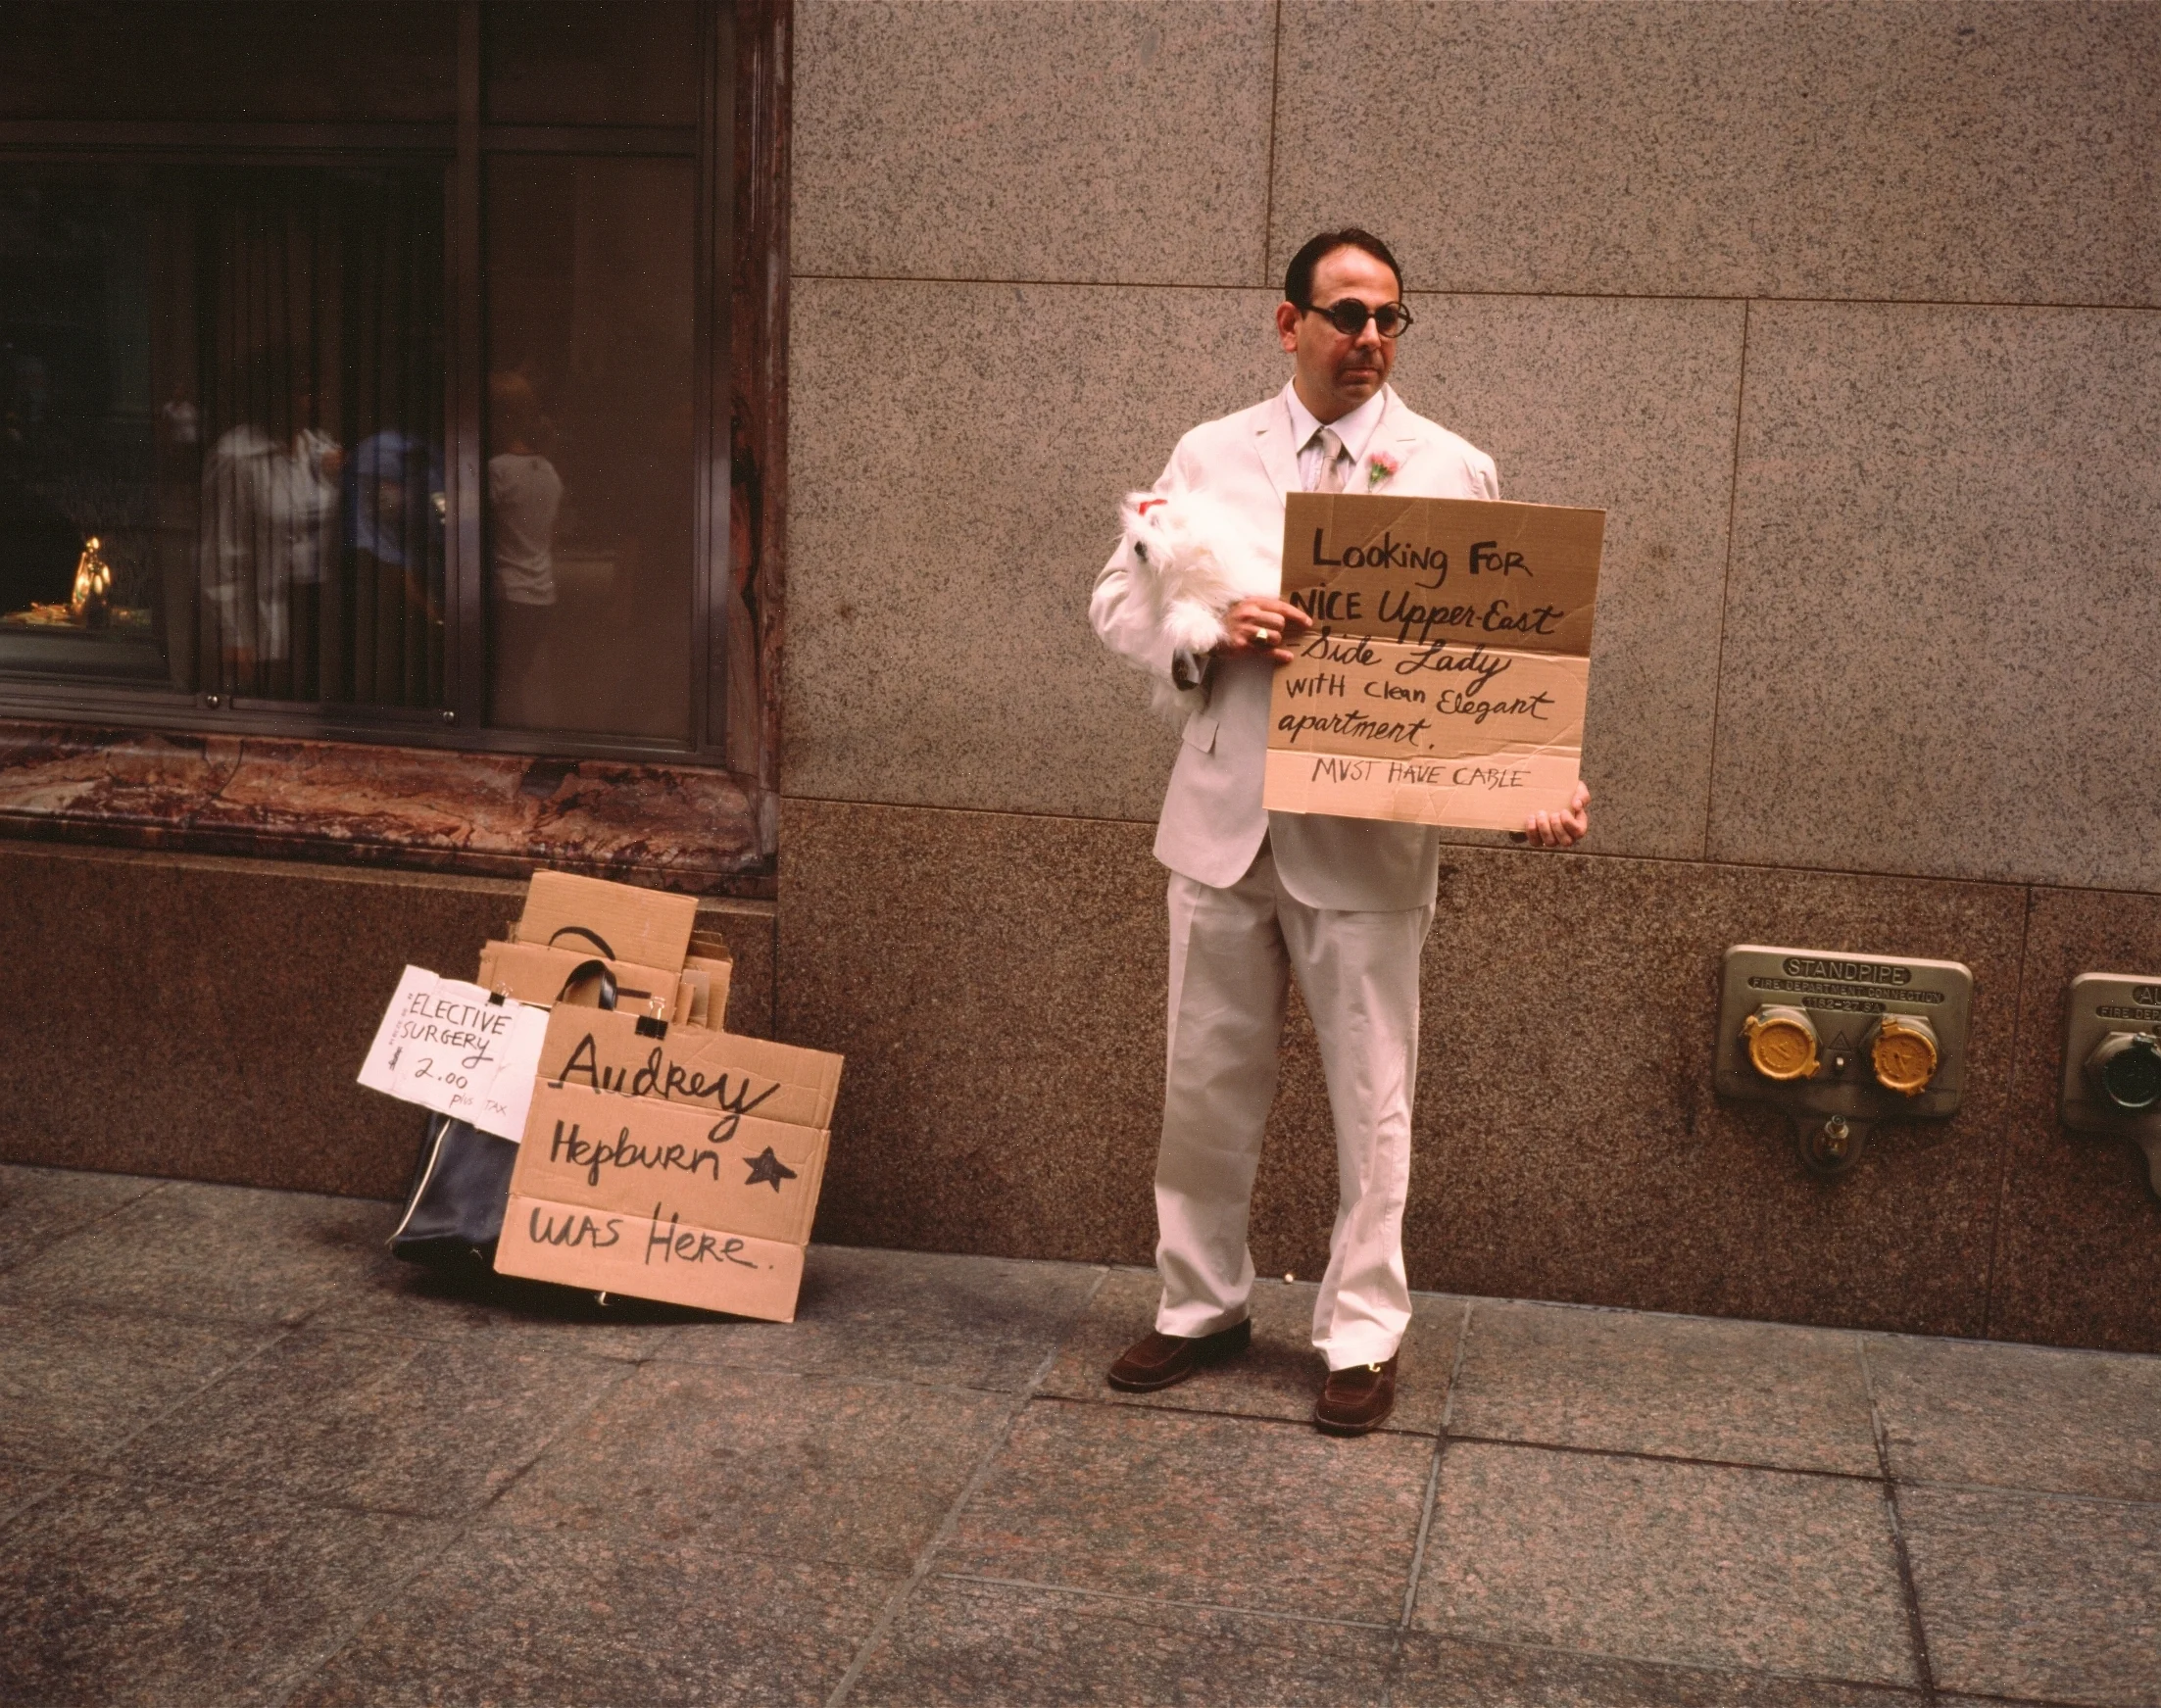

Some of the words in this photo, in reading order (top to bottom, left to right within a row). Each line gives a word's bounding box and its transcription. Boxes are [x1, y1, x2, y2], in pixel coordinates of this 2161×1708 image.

[1289, 582, 1363, 621] NICE
[1395, 639, 1512, 698] Lady
[1436, 689, 1555, 725] Elegant
[1277, 709, 1435, 750] apartment.
[1388, 761, 1447, 784] HAVE
[1451, 767, 1532, 791] CABLE
[1752, 979, 1781, 991] FIRE
[1786, 981, 1863, 998] DEPARTMENT
[1868, 988, 1941, 1003] CONNECTION
[1787, 958, 1906, 985] STANDPIPE
[2100, 1006, 2130, 1018] FIRE
[400, 1020, 494, 1069] SURGERY
[448, 1093, 474, 1109] plus
[484, 1099, 509, 1116] TAX
[547, 1032, 781, 1144] Audrey
[550, 1119, 719, 1187] Hepburn
[529, 1206, 624, 1248] WAS
